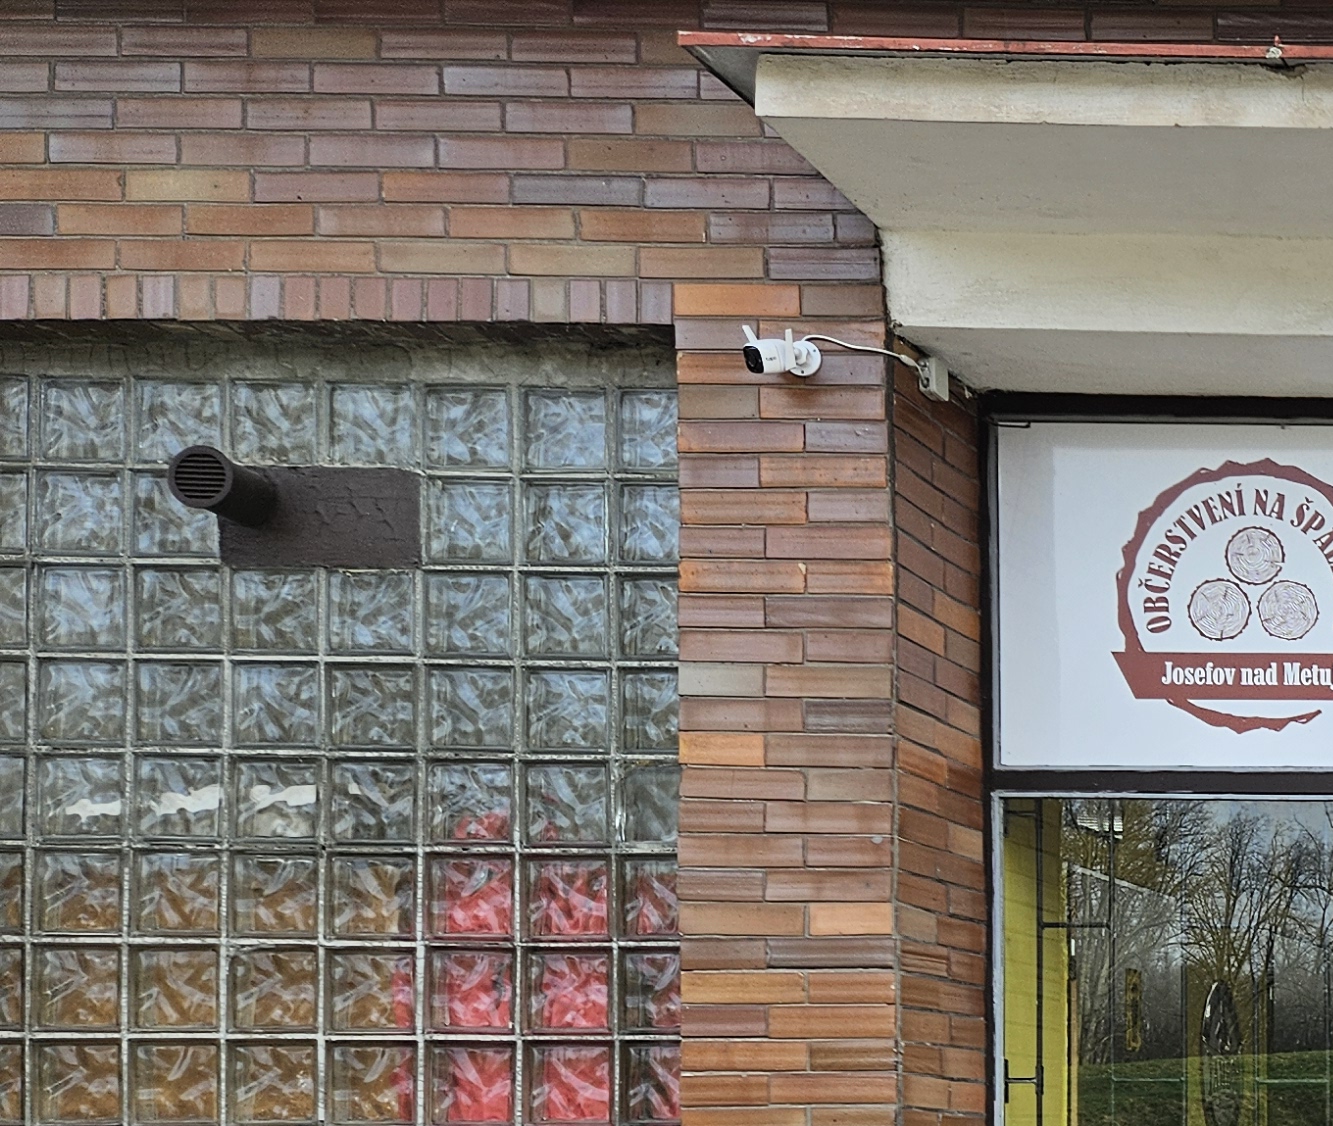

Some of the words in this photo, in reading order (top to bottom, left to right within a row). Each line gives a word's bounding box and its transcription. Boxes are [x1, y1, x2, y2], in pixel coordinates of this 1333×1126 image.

[1138, 483, 1247, 634] OBČERSTVENÍ
[1253, 488, 1285, 521] NA
[1161, 661, 1236, 686] Josefov
[1240, 663, 1278, 685] nad
